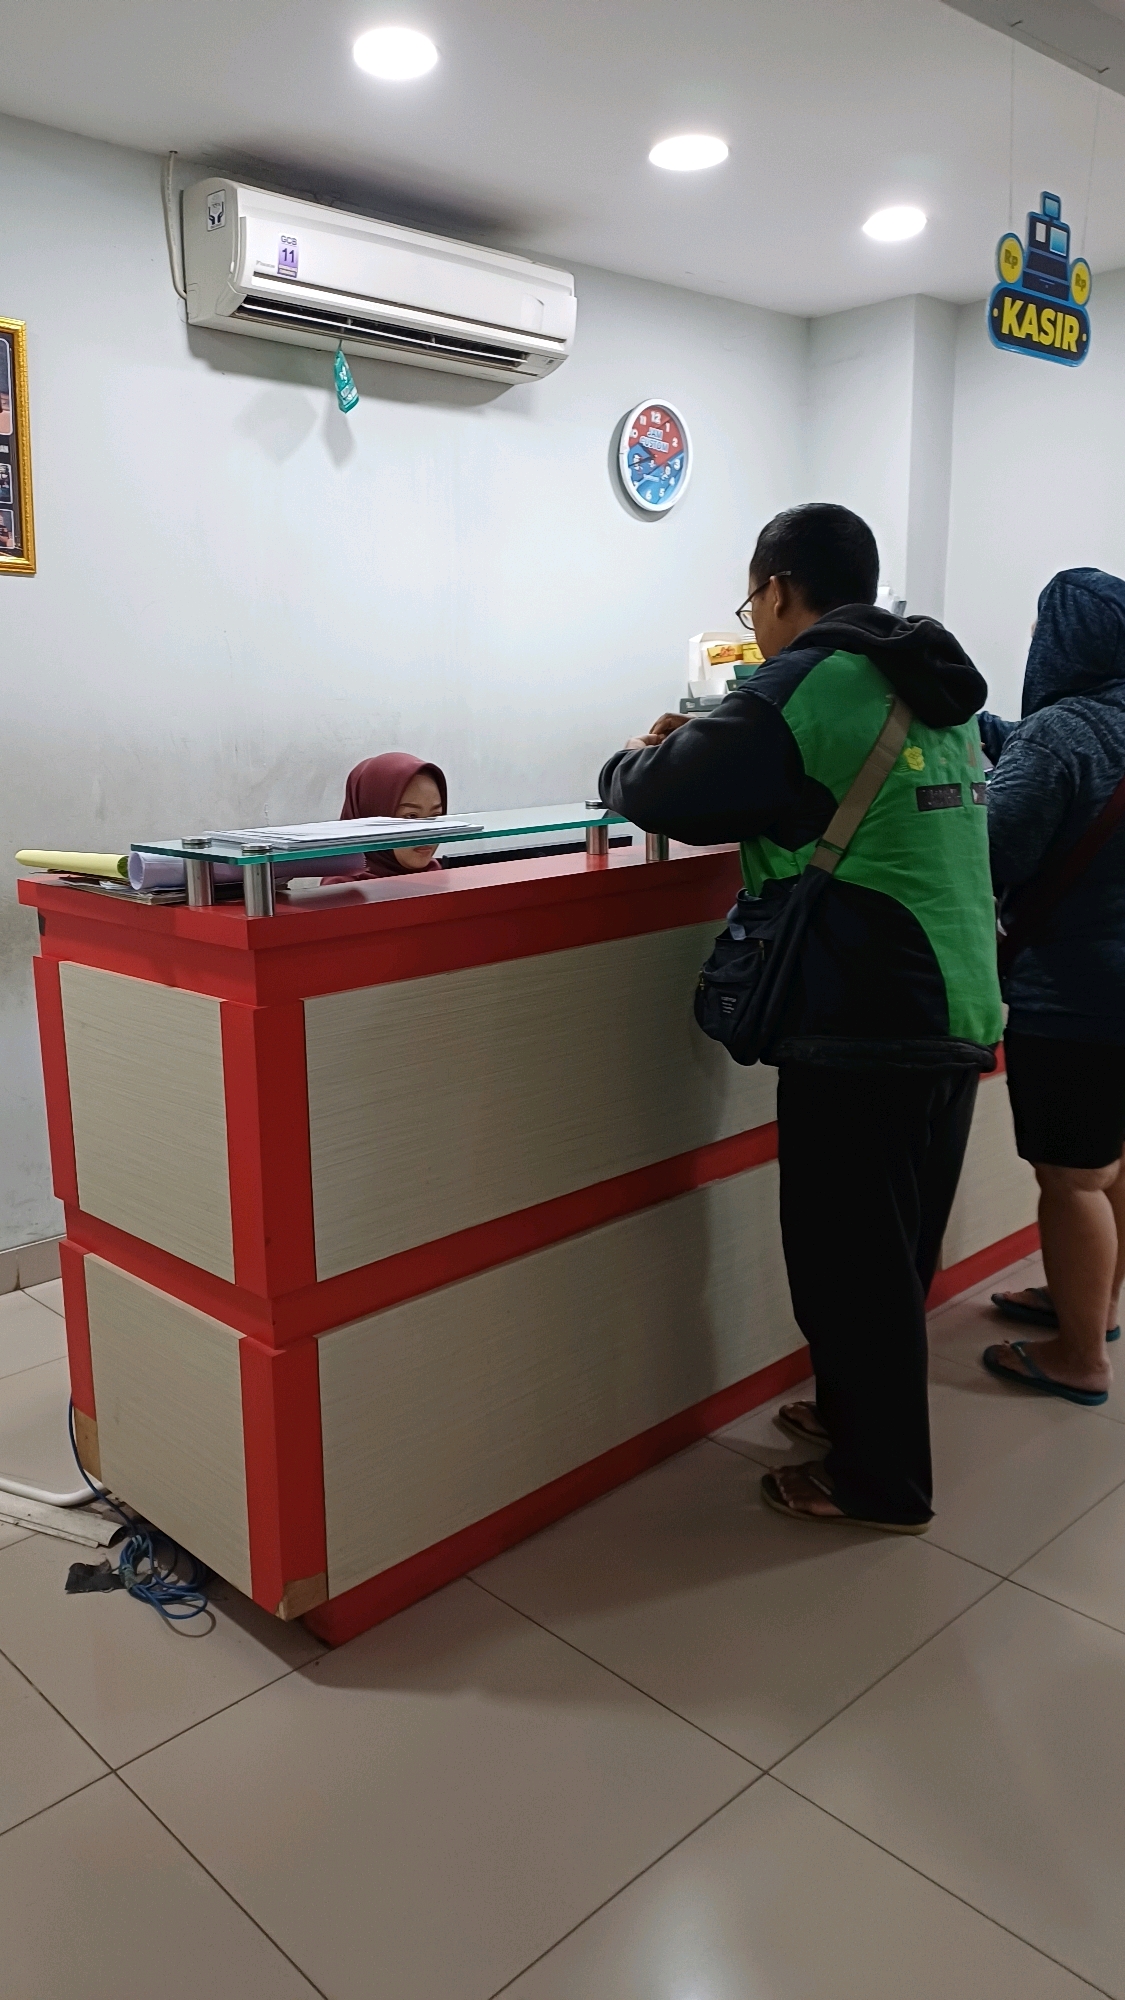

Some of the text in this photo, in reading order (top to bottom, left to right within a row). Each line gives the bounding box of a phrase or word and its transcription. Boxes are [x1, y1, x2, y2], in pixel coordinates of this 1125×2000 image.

[282, 247, 295, 263] 11
[1004, 249, 1018, 269] Rp
[1075, 273, 1086, 292] Rp
[1001, 296, 1080, 353] KASIR
[651, 411, 661, 424] 12
[665, 423, 670, 432] 1
[672, 437, 678, 447] 2
[674, 459, 680, 470] 3
[646, 489, 652, 500] 6
[659, 488, 665, 497] 5
